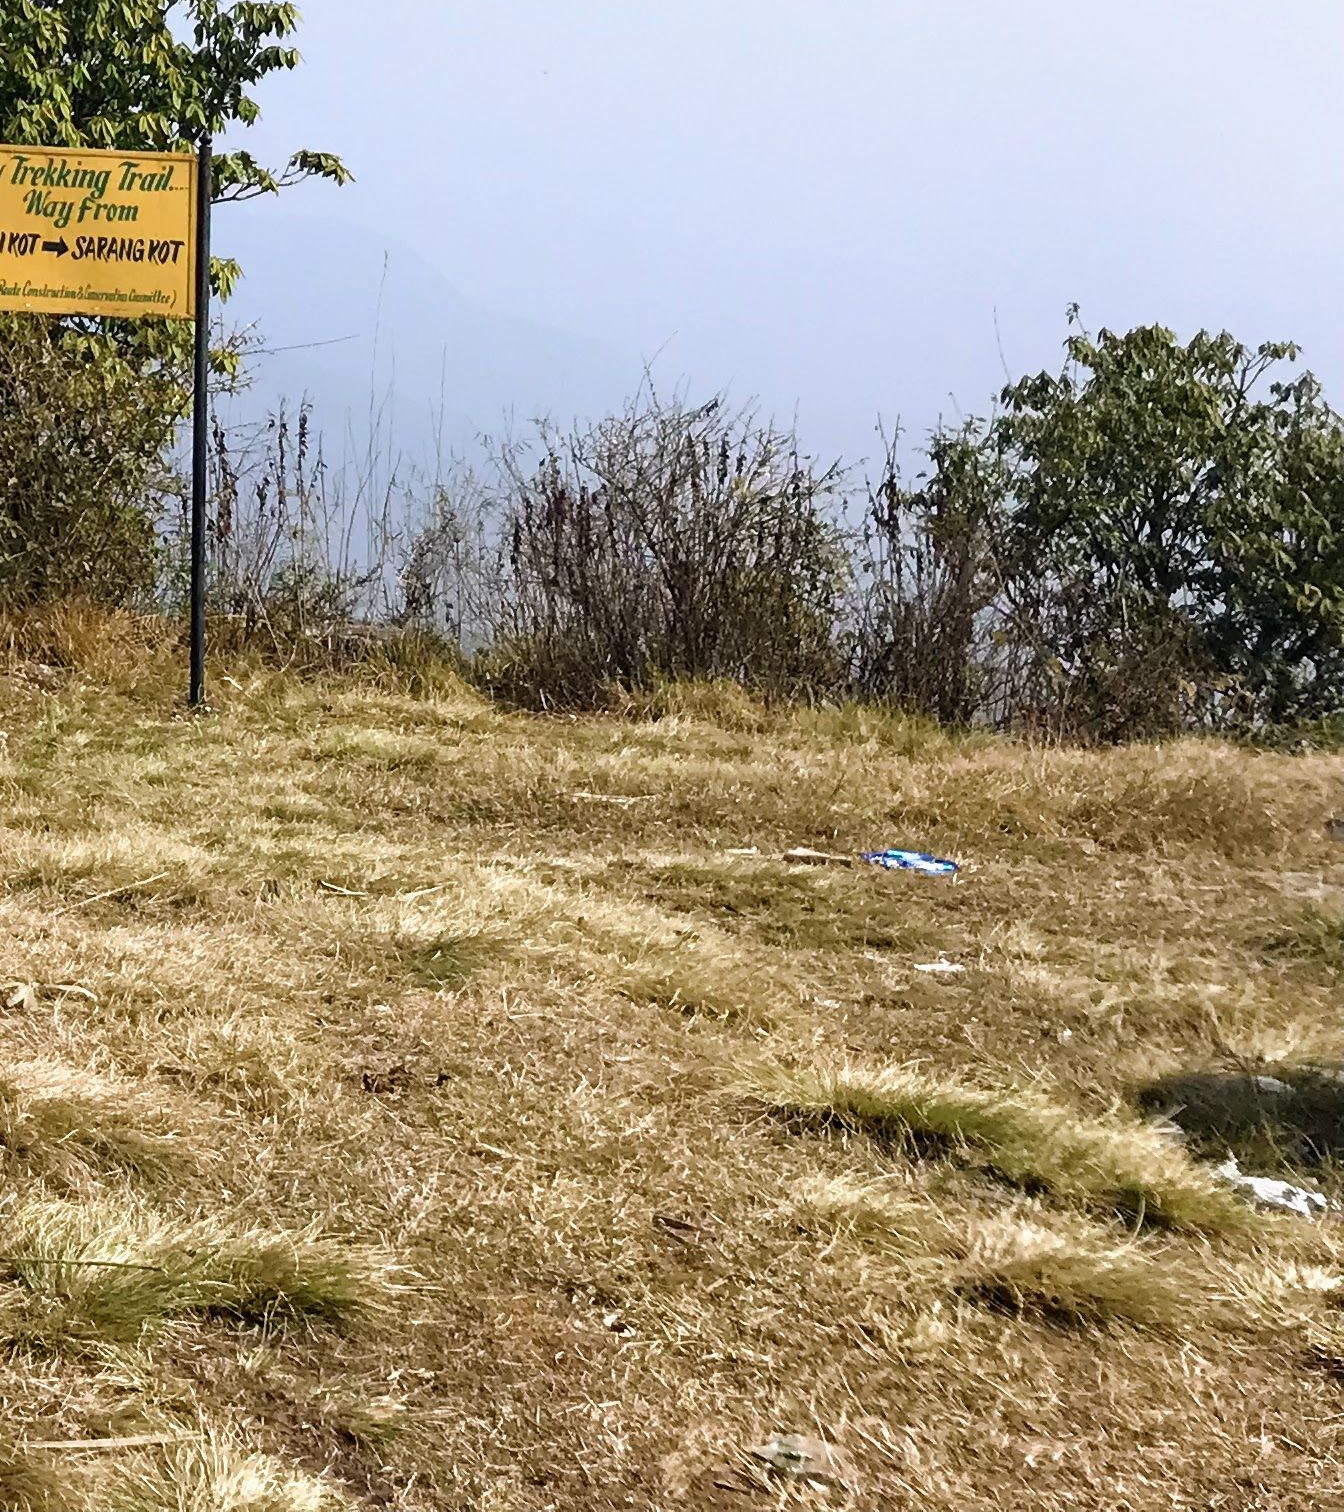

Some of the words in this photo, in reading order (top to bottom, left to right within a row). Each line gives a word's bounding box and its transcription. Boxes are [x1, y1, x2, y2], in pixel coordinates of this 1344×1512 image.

[11, 155, 112, 199] Trekking
[23, 189, 74, 229] Way
[7, 233, 41, 258] KOT
[71, 236, 144, 263] SARANG
[148, 239, 186, 265] KOT
